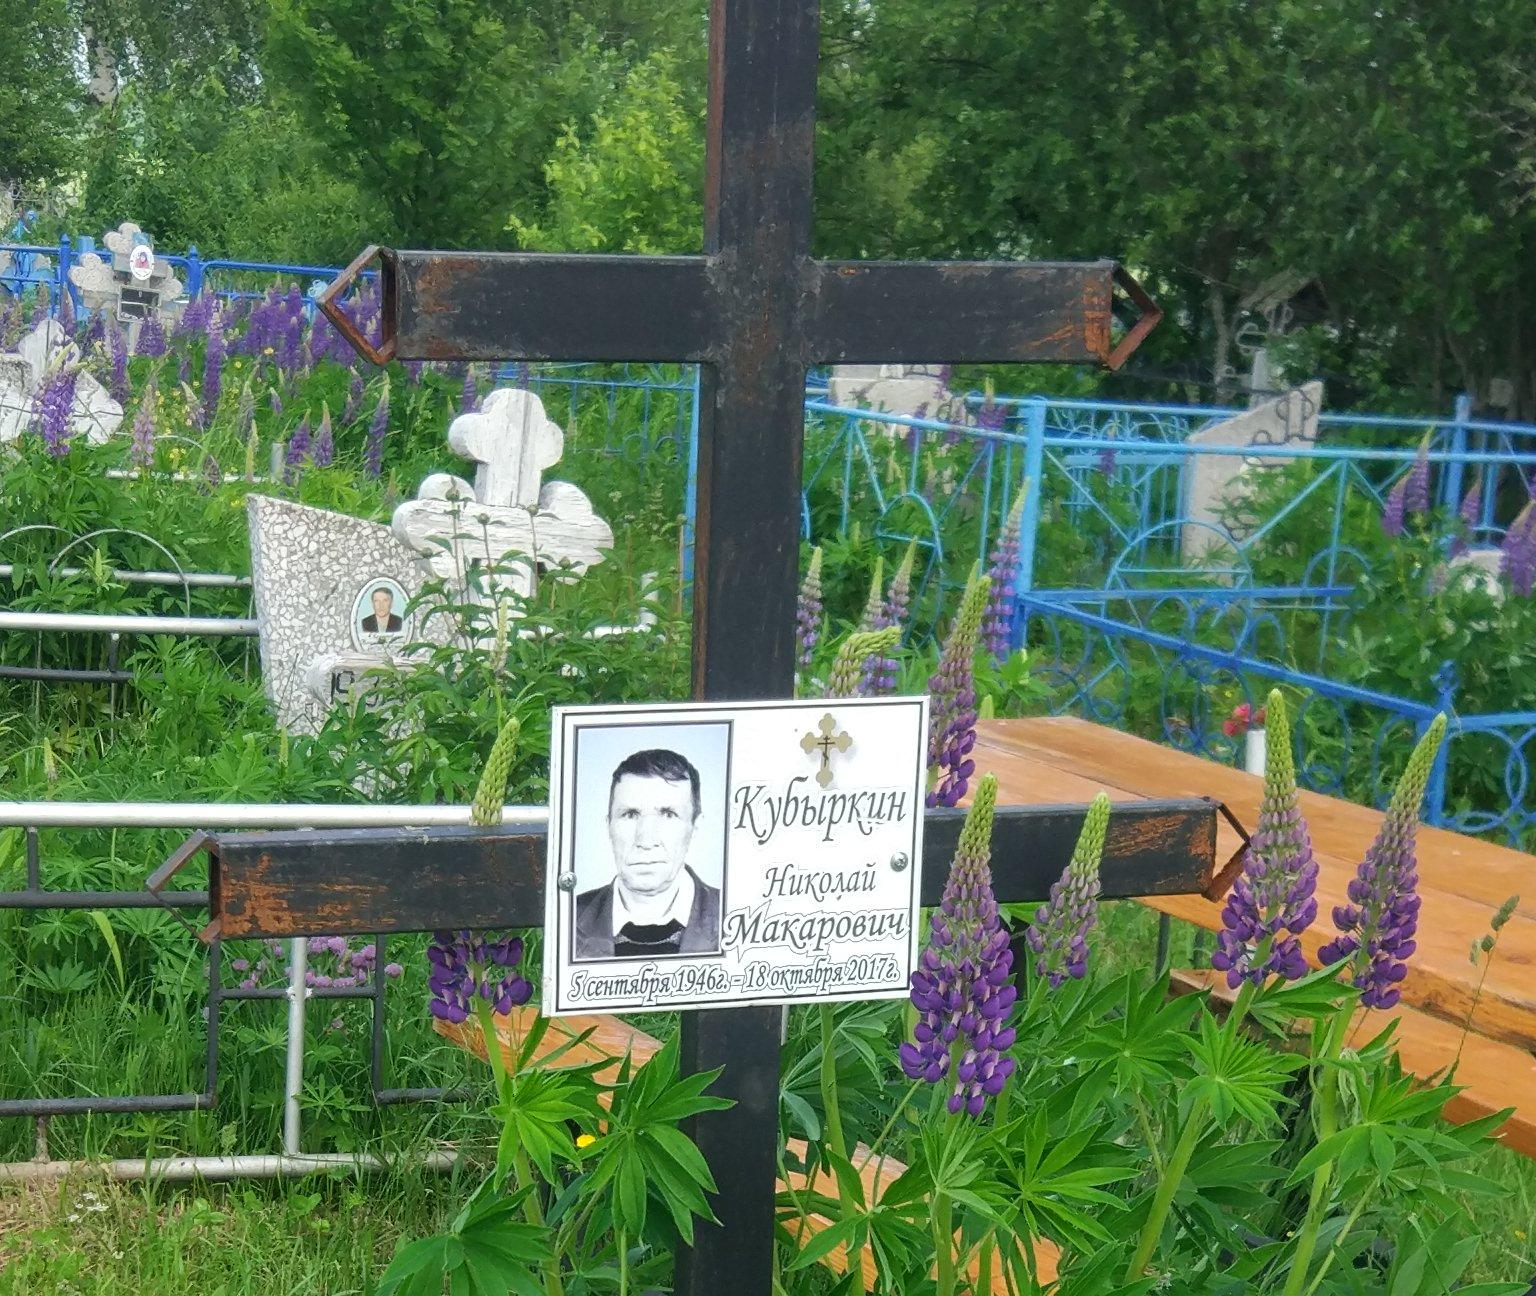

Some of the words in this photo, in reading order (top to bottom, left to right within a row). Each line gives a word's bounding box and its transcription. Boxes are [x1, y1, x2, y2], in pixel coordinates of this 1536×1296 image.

[734, 776, 906, 845] Кубыркин
[763, 863, 877, 902] Николай
[725, 911, 905, 951] Макарович
[571, 974, 583, 998] 5
[587, 968, 670, 1001] сентября
[676, 968, 727, 992] 1946г.
[746, 965, 767, 988] 18
[770, 958, 843, 991] октября
[848, 957, 897, 981] 2017г.
